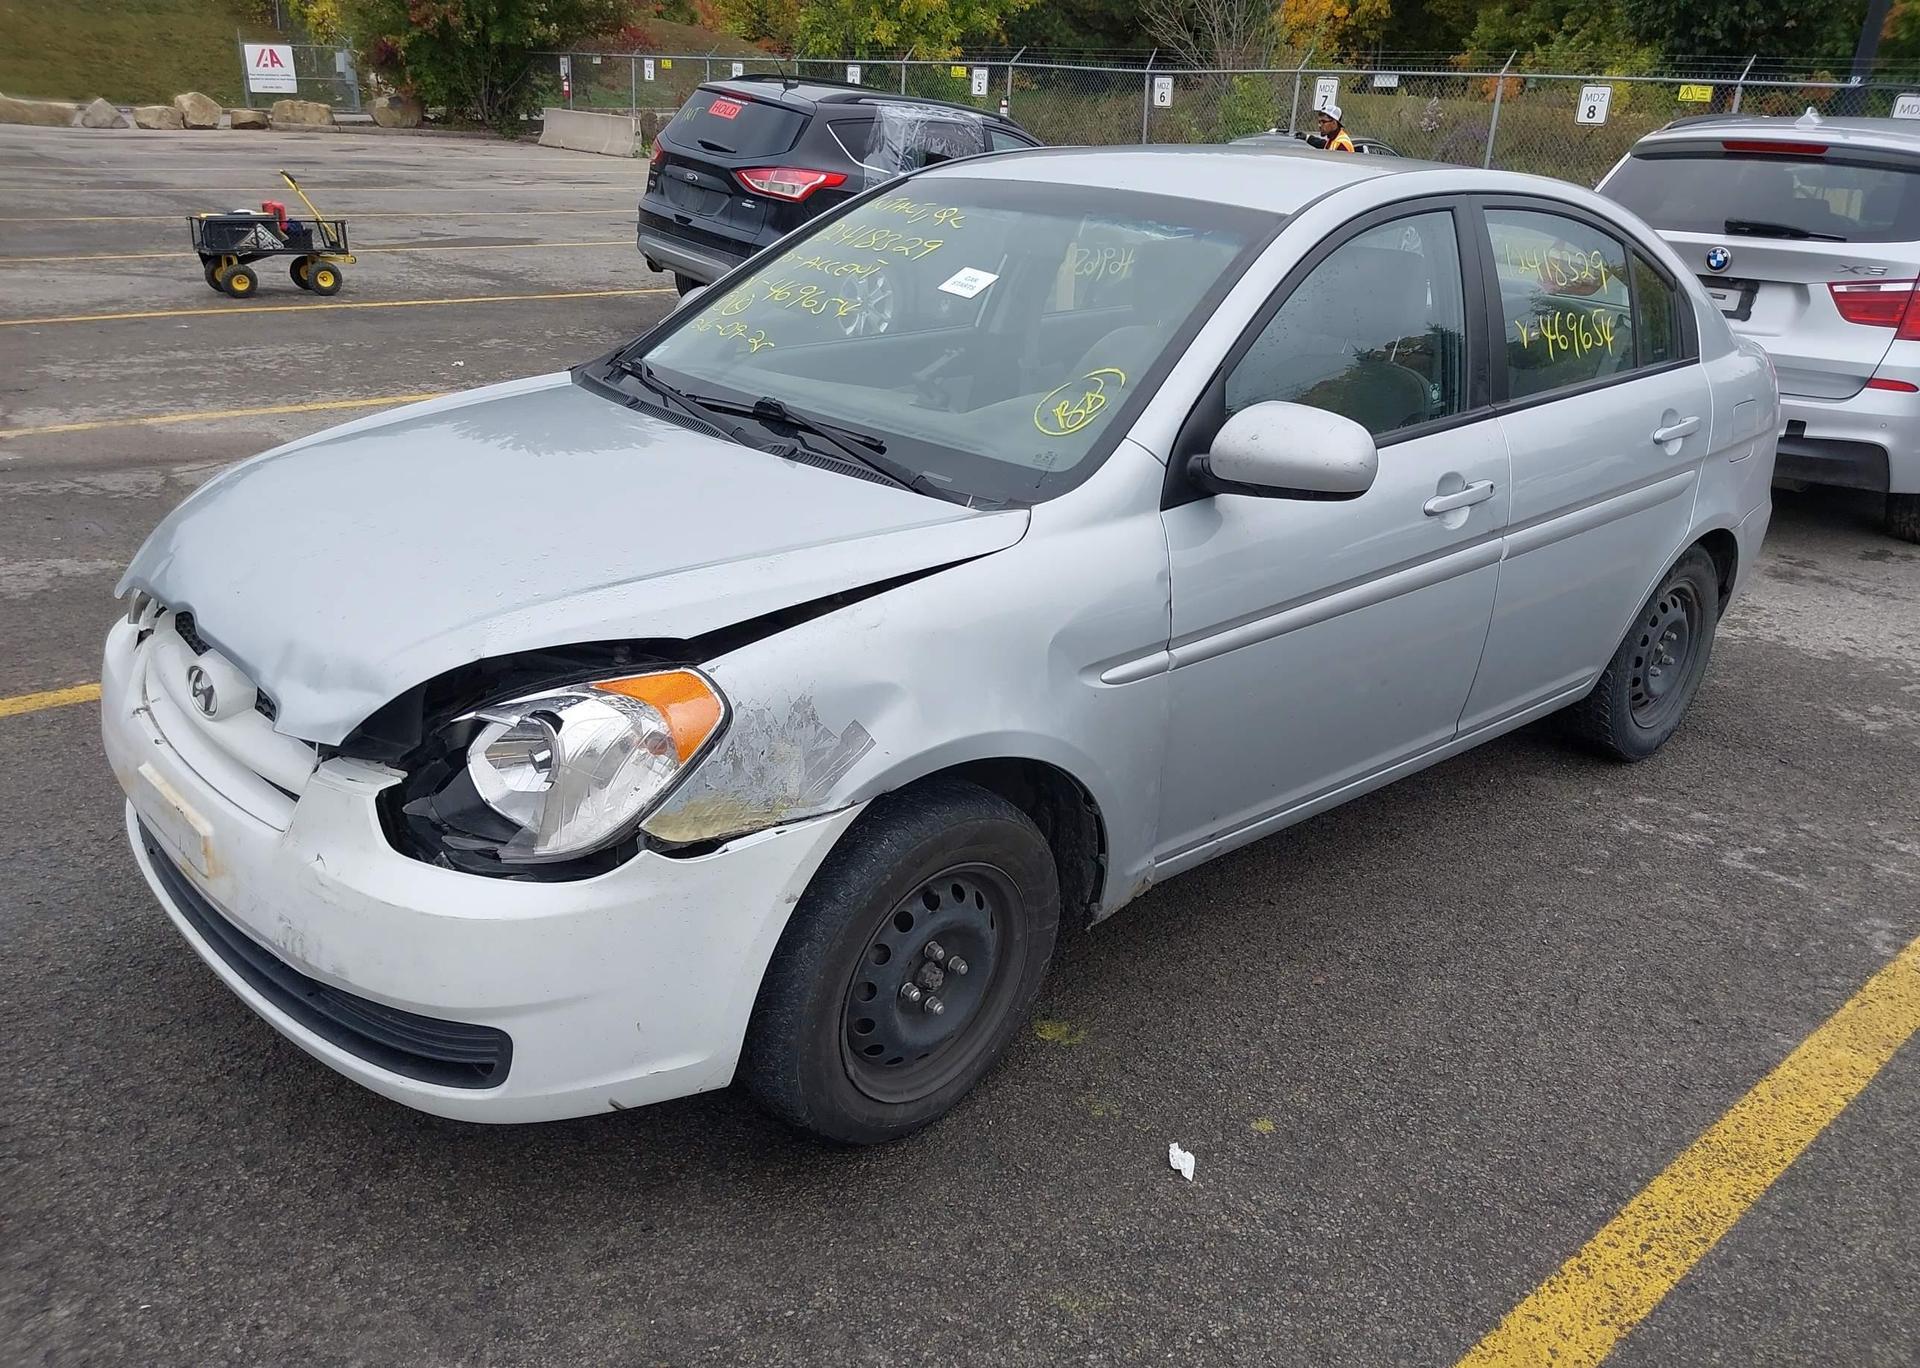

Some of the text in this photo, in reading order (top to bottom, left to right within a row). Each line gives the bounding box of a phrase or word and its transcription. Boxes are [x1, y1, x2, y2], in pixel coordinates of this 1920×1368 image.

[977, 81, 983, 92] 5
[1157, 82, 1170, 90] MDZ
[1319, 84, 1335, 93] MDZ
[1160, 91, 1166, 103] 6
[1321, 95, 1329, 108] 7
[1584, 93, 1606, 102] MDZ
[712, 101, 738, 116] HOLD
[1586, 105, 1597, 119] 8
[1899, 103, 1920, 115] MD
[1504, 242, 1607, 294] 12418329
[1834, 263, 1888, 276] X3
